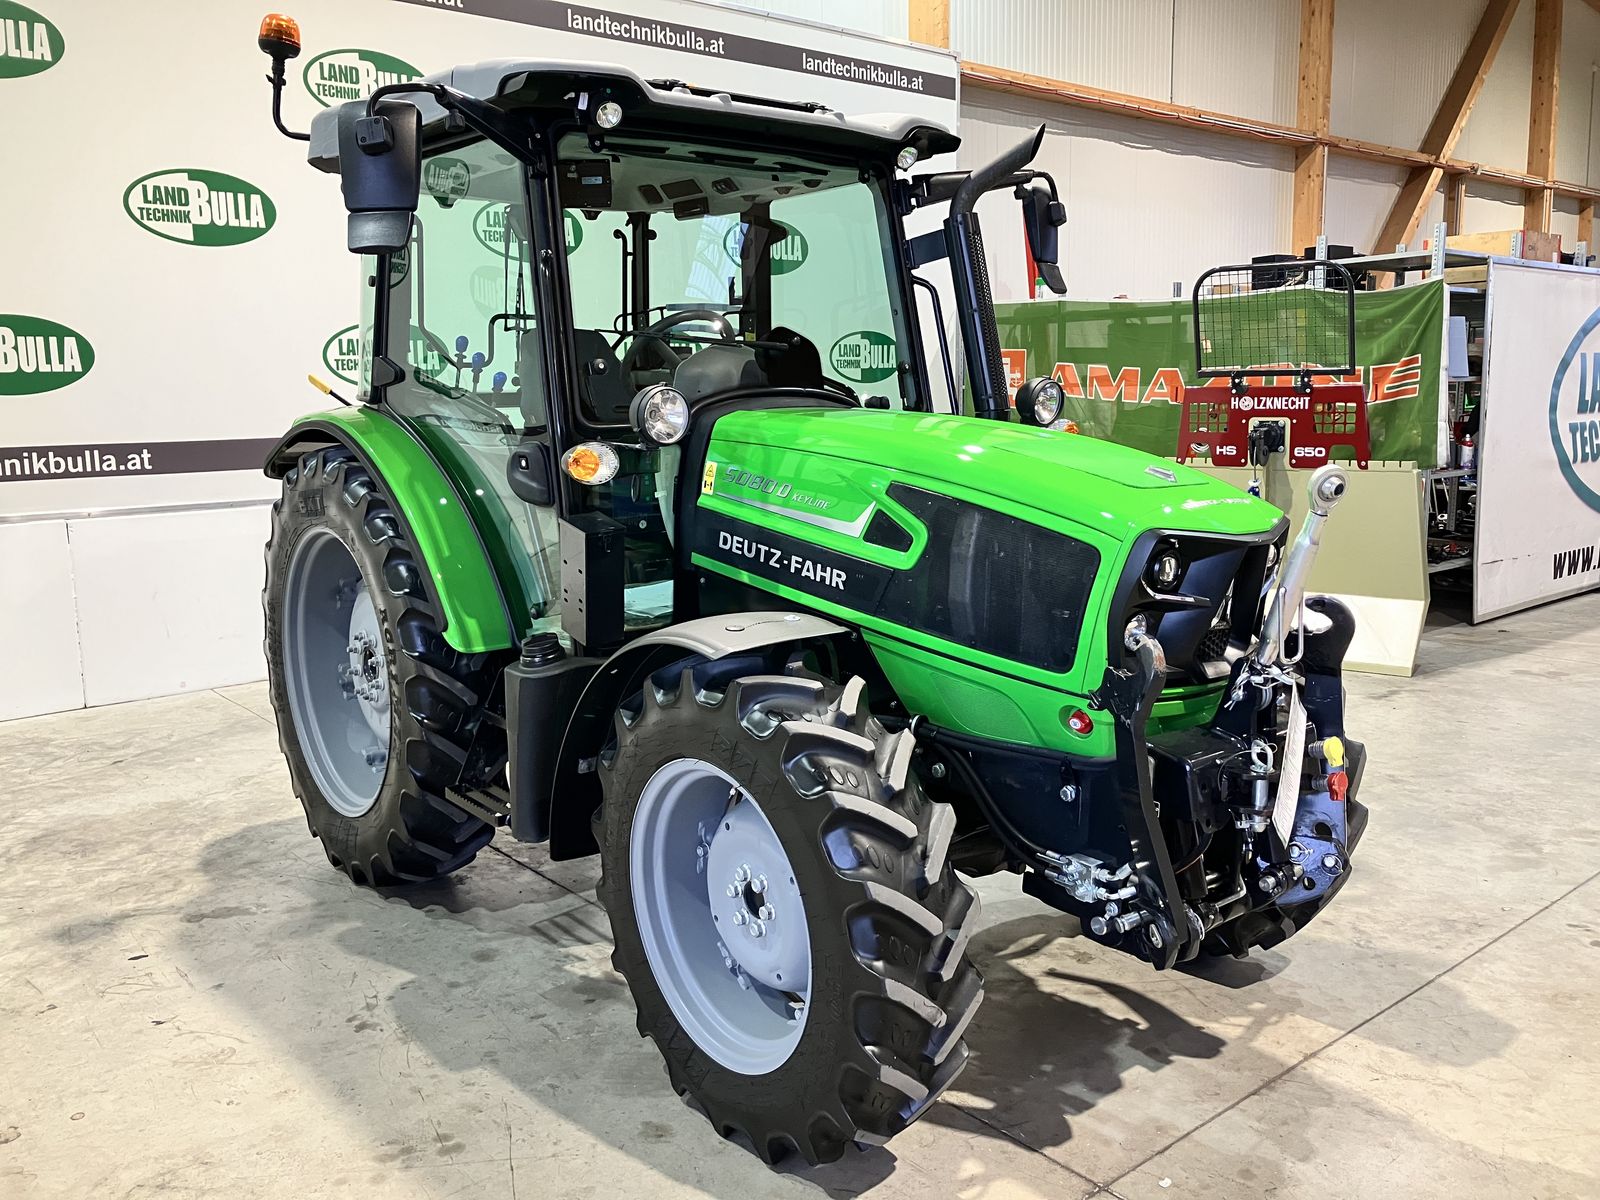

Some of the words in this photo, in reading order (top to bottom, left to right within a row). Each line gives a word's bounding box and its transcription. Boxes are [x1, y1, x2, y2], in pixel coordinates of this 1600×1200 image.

[567, 9, 724, 54] landtechnikbulla.at
[319, 61, 360, 84] LAND
[802, 53, 923, 90] landtechnikbulla.at
[315, 83, 360, 100] TECHNIK
[141, 184, 190, 207] LAND
[188, 180, 266, 228] BULLA
[137, 207, 192, 223] TECHNIK
[770, 235, 803, 261] ULLA
[0, 326, 82, 373] BULLA
[838, 344, 861, 358] LAND
[861, 339, 897, 369] BULLA
[836, 360, 861, 369] TECHNIK
[0, 448, 153, 476] nikbulla.at
[1216, 446, 1237, 456] HS
[1294, 447, 1326, 458] 650
[724, 465, 779, 495] 5080
[776, 483, 793, 499] D
[791, 492, 831, 511] KEYLINE
[719, 531, 847, 590] DEUTZ-FAHR
